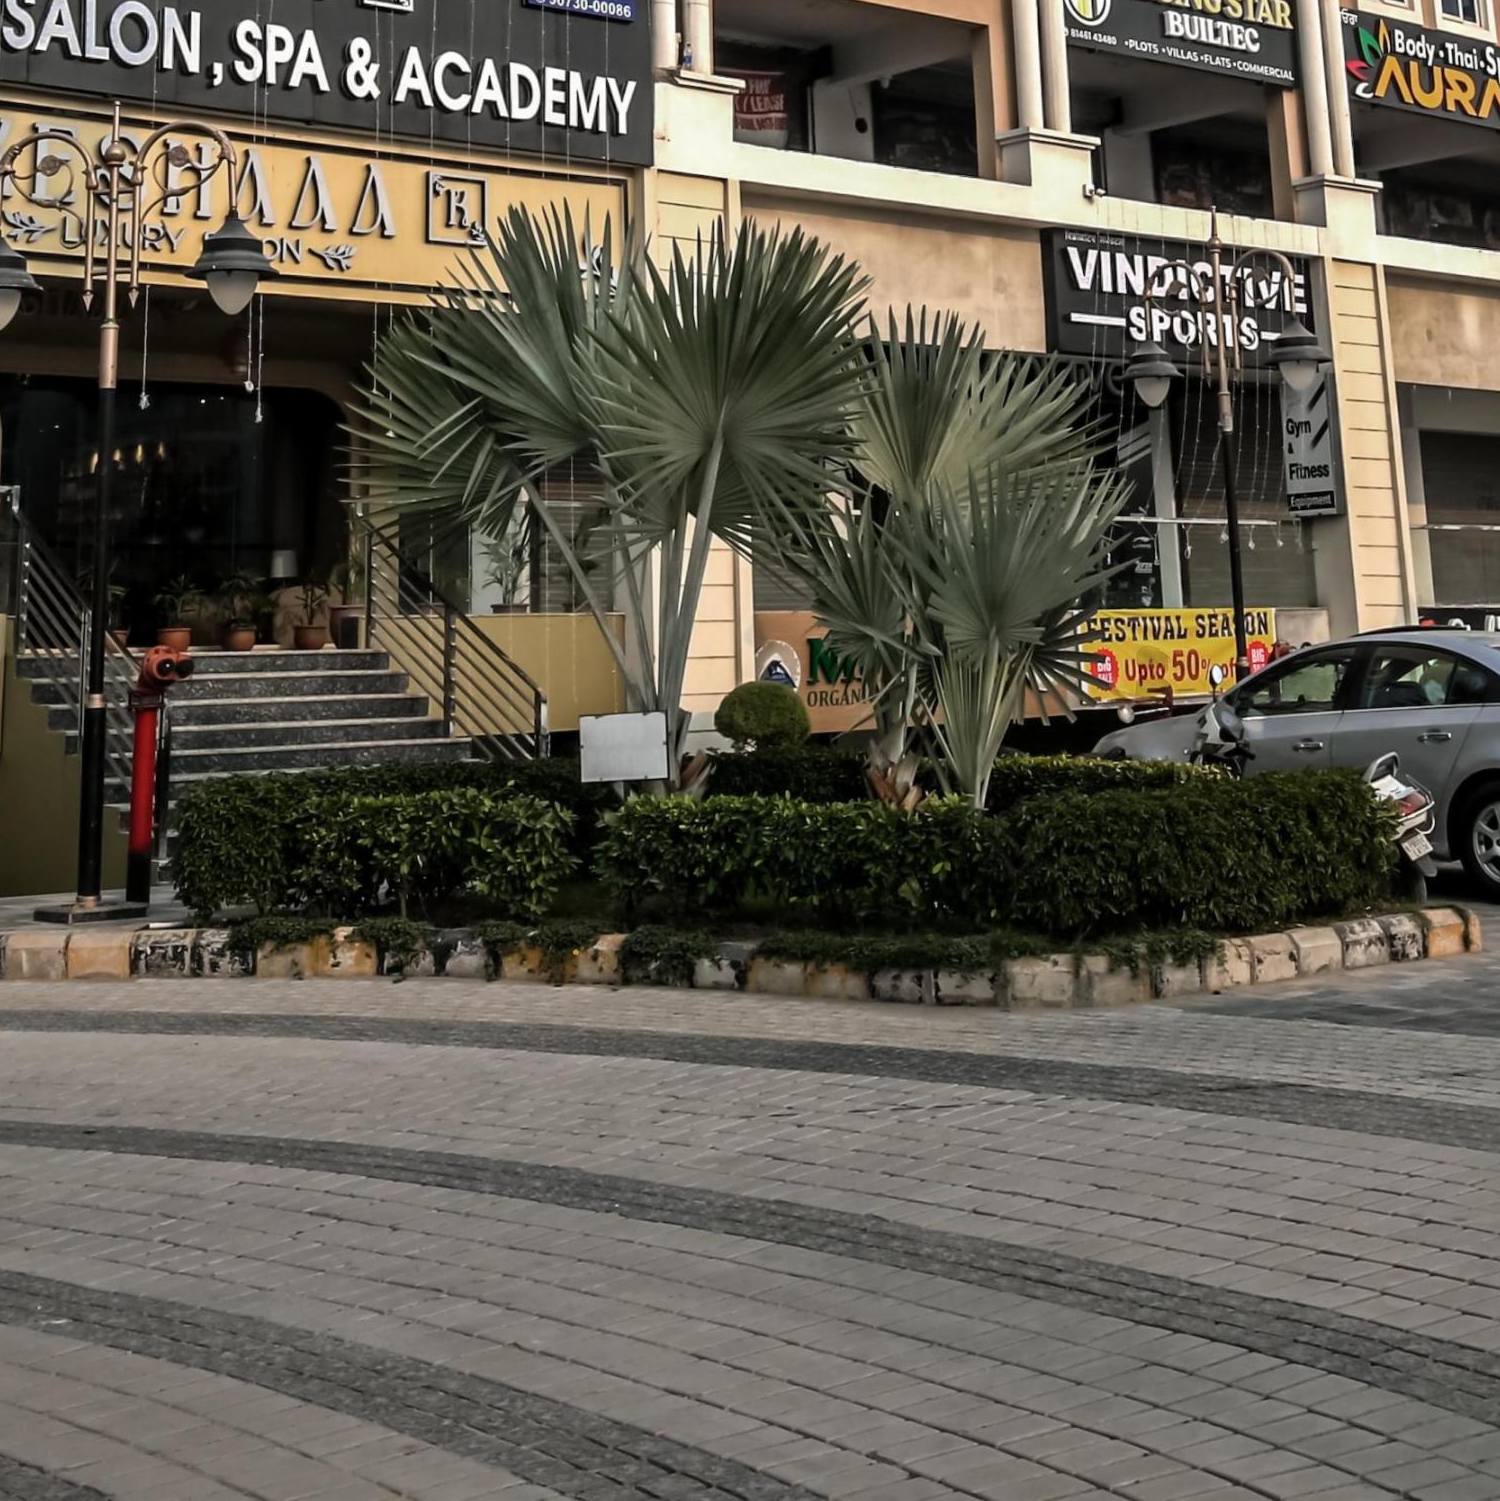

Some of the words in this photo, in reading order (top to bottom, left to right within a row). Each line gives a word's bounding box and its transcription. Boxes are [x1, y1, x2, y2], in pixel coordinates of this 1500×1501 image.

[1162, 10, 1261, 53] BUILTEC
[1128, 38, 1159, 54] PLOTS
[1166, 46, 1199, 62] VILLAS
[1204, 54, 1232, 69] FLATS
[1237, 60, 1295, 82] COMMERCIAL
[1393, 28, 1436, 67] Body
[1444, 42, 1479, 72] Thai
[232, 18, 331, 93] SPA
[343, 35, 381, 100] &
[393, 45, 638, 136] ACADEMY
[1285, 417, 1312, 439] Gym
[1288, 463, 1330, 481] Fitness
[1087, 615, 1189, 643] FESTIVAL
[1195, 611, 1269, 639] SEAON
[1251, 647, 1266, 663] BIG
[1124, 657, 1166, 687] Upto
[806, 689, 867, 708] ORGAN
